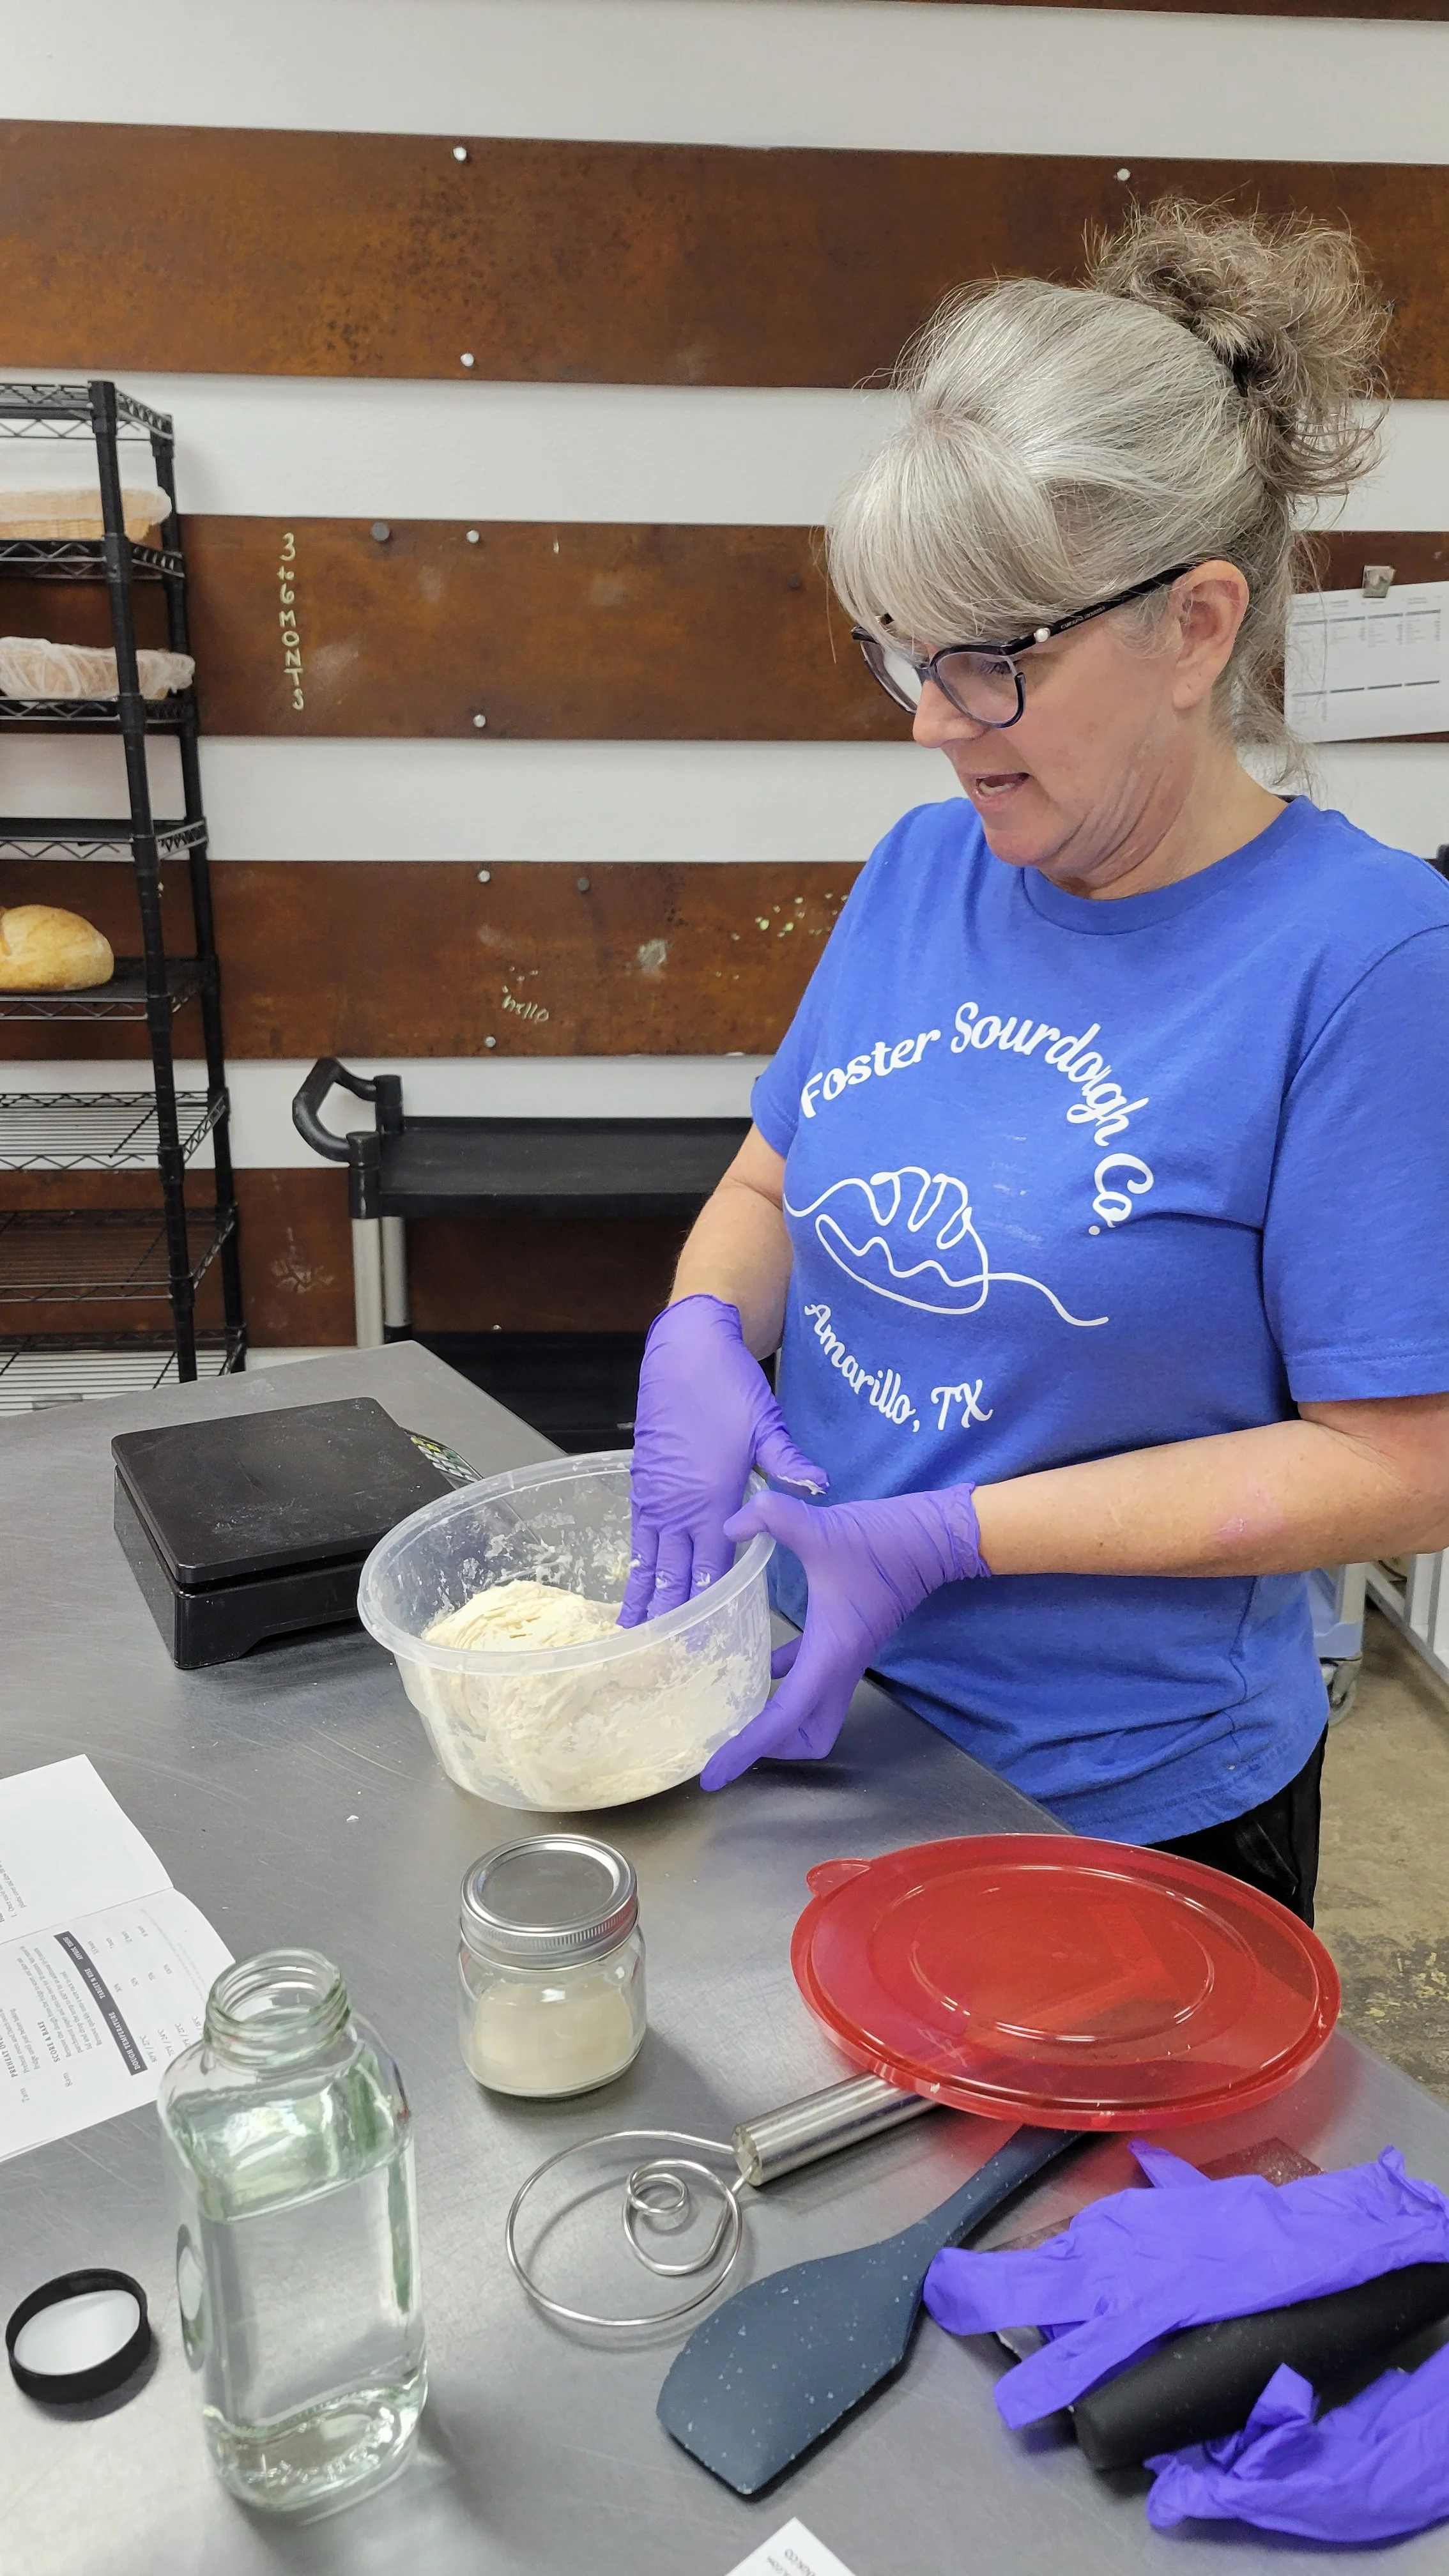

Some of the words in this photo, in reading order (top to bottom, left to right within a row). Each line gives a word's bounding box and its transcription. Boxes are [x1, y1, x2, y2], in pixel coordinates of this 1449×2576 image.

[280, 532, 295, 562] 3
[277, 566, 295, 580] to
[279, 583, 295, 604] 6
[801, 1029, 941, 1117] Foster
[951, 1001, 1149, 1146] Sourdough
[1088, 1153, 1153, 1235] Co.
[804, 1304, 919, 1432] Amarillo,
[931, 1379, 993, 1430] TX
[92, 1982, 105, 1998] TARGET
[37, 2021, 49, 2035] BAKE
[109, 2012, 130, 2049] TEMPERATURE
[47, 2042, 60, 2062] SCORE
[126, 2049, 140, 2069] DOUGH
[1, 2050, 17, 2077] PREHEAT
[63, 2072, 72, 2087] 8am
